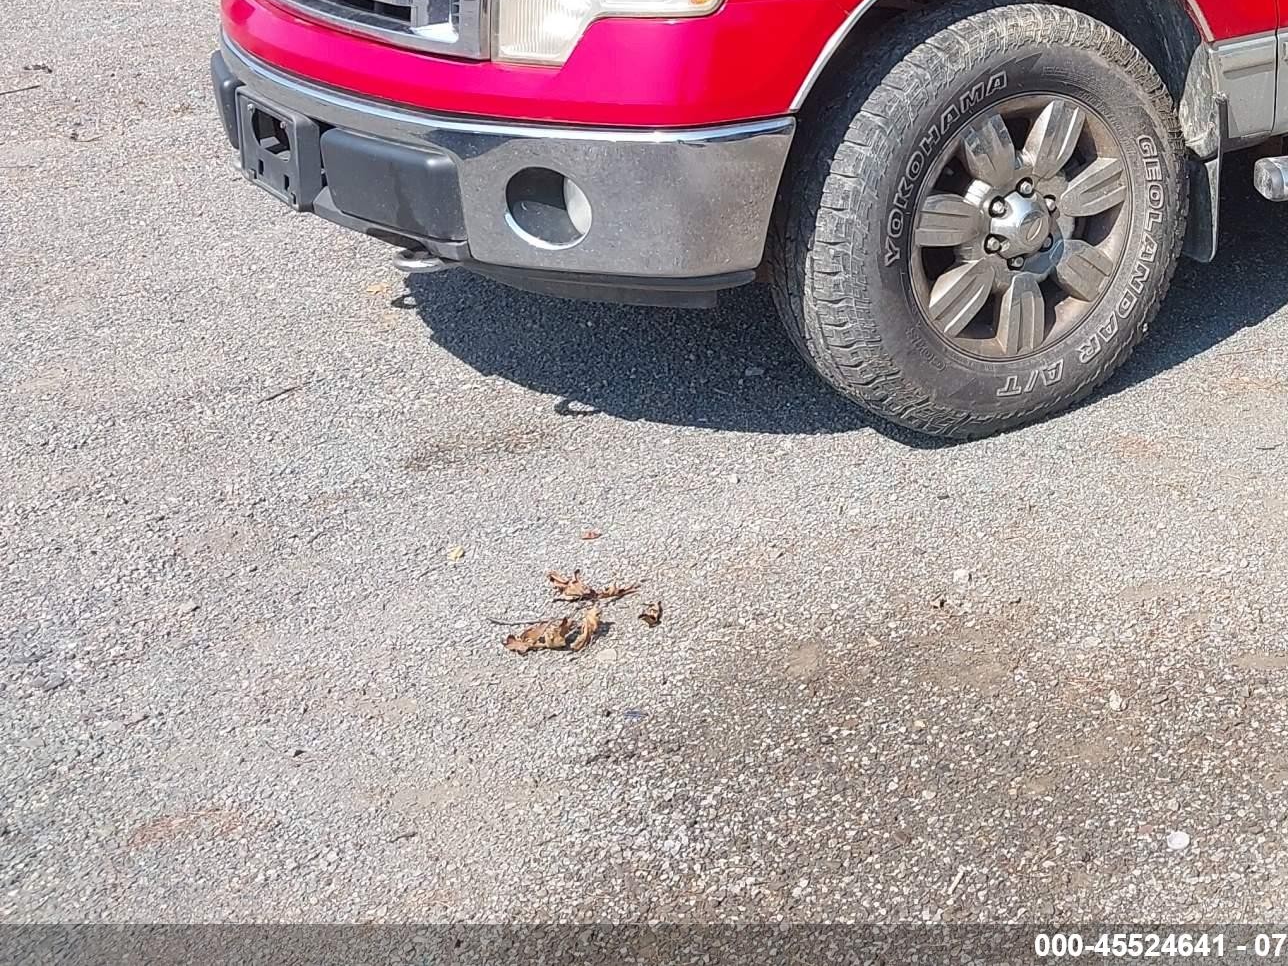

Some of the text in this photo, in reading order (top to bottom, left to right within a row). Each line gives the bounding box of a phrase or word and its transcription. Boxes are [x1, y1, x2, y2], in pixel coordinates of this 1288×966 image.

[885, 71, 1008, 267] YOKOHAMA
[1076, 134, 1165, 364] GEOLANDAR
[996, 358, 1064, 397] A/T
